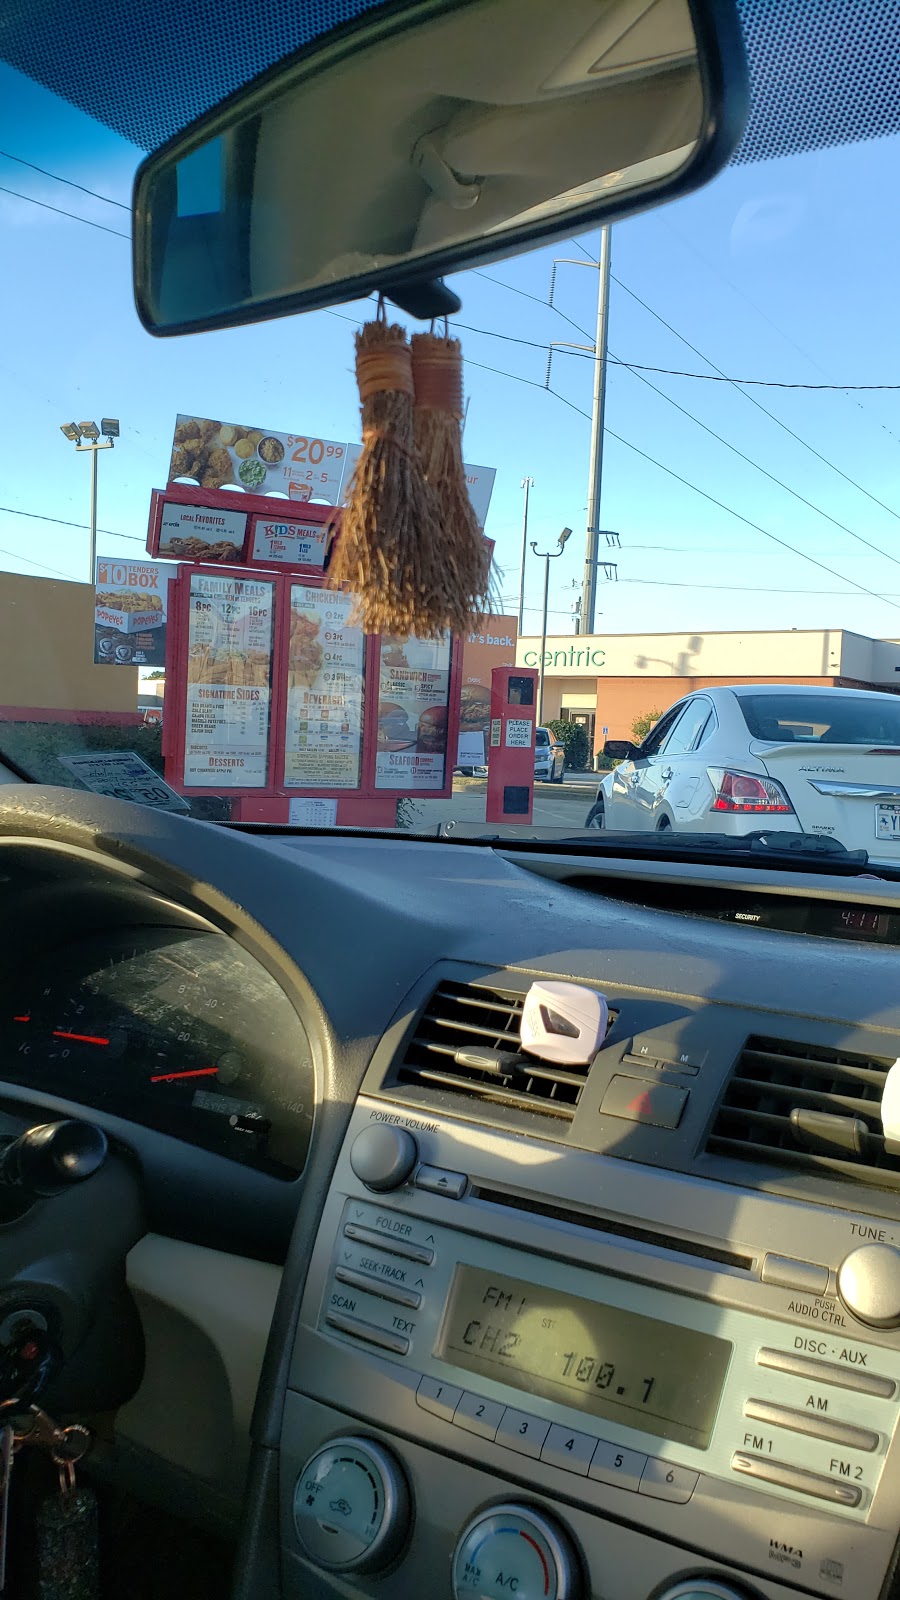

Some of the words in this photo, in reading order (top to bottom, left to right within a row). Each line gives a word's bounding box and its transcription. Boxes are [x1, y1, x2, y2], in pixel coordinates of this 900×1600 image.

[283, 467, 292, 477] 11
[306, 470, 313, 480] 2
[321, 473, 328, 483] 5
[195, 515, 225, 526] FAVORITES
[297, 529, 316, 538] MEALS
[100, 564, 126, 585] $10
[128, 566, 158, 574] TENDERS
[128, 573, 158, 588] BOX
[199, 579, 232, 593] FAMILY
[235, 583, 265, 596] MEALS
[306, 590, 338, 604] CHICKEN
[97, 609, 123, 625] POPEYES
[486, 634, 514, 646] back.
[524, 645, 606, 667] centric
[390, 669, 427, 682] SANDWICH
[198, 689, 235, 699] SIGNATURE
[236, 688, 259, 700] SIDES
[209, 757, 245, 767] DESSERTS
[389, 754, 419, 766] SEAFOOD
[734, 912, 761, 922] SECURITY
[841, 911, 878, 929] 4:11
[178, 985, 186, 993] 8
[76, 1005, 85, 1014] 2
[205, 1000, 217, 1008] 40
[177, 1032, 190, 1041] 20
[62, 1049, 70, 1058] 0
[287, 1102, 304, 1113] 140
[375, 1216, 412, 1236] FOLDER
[850, 1222, 886, 1242] TUNE
[331, 1294, 356, 1312] SCAN
[815, 1298, 836, 1311] PUSH
[787, 1300, 820, 1318] AUDIO
[821, 1309, 847, 1327] CTRL
[392, 1316, 416, 1334] TEXT
[463, 1320, 520, 1358] CH2
[794, 1337, 827, 1355] DISC
[839, 1348, 868, 1366] AUX
[562, 1352, 655, 1403] 100.1
[436, 1387, 443, 1398] 1
[805, 1396, 828, 1411] AM
[476, 1405, 486, 1417] 2
[519, 1422, 528, 1434] 3
[565, 1438, 575, 1451] 4
[614, 1455, 624, 1468] 5
[666, 1470, 674, 1483] 6
[305, 1480, 324, 1493] OFF
[770, 1539, 803, 1558] WMA
[464, 1564, 481, 1575] MAX
[463, 1574, 479, 1586] A/C
[495, 1572, 519, 1591] A/C
